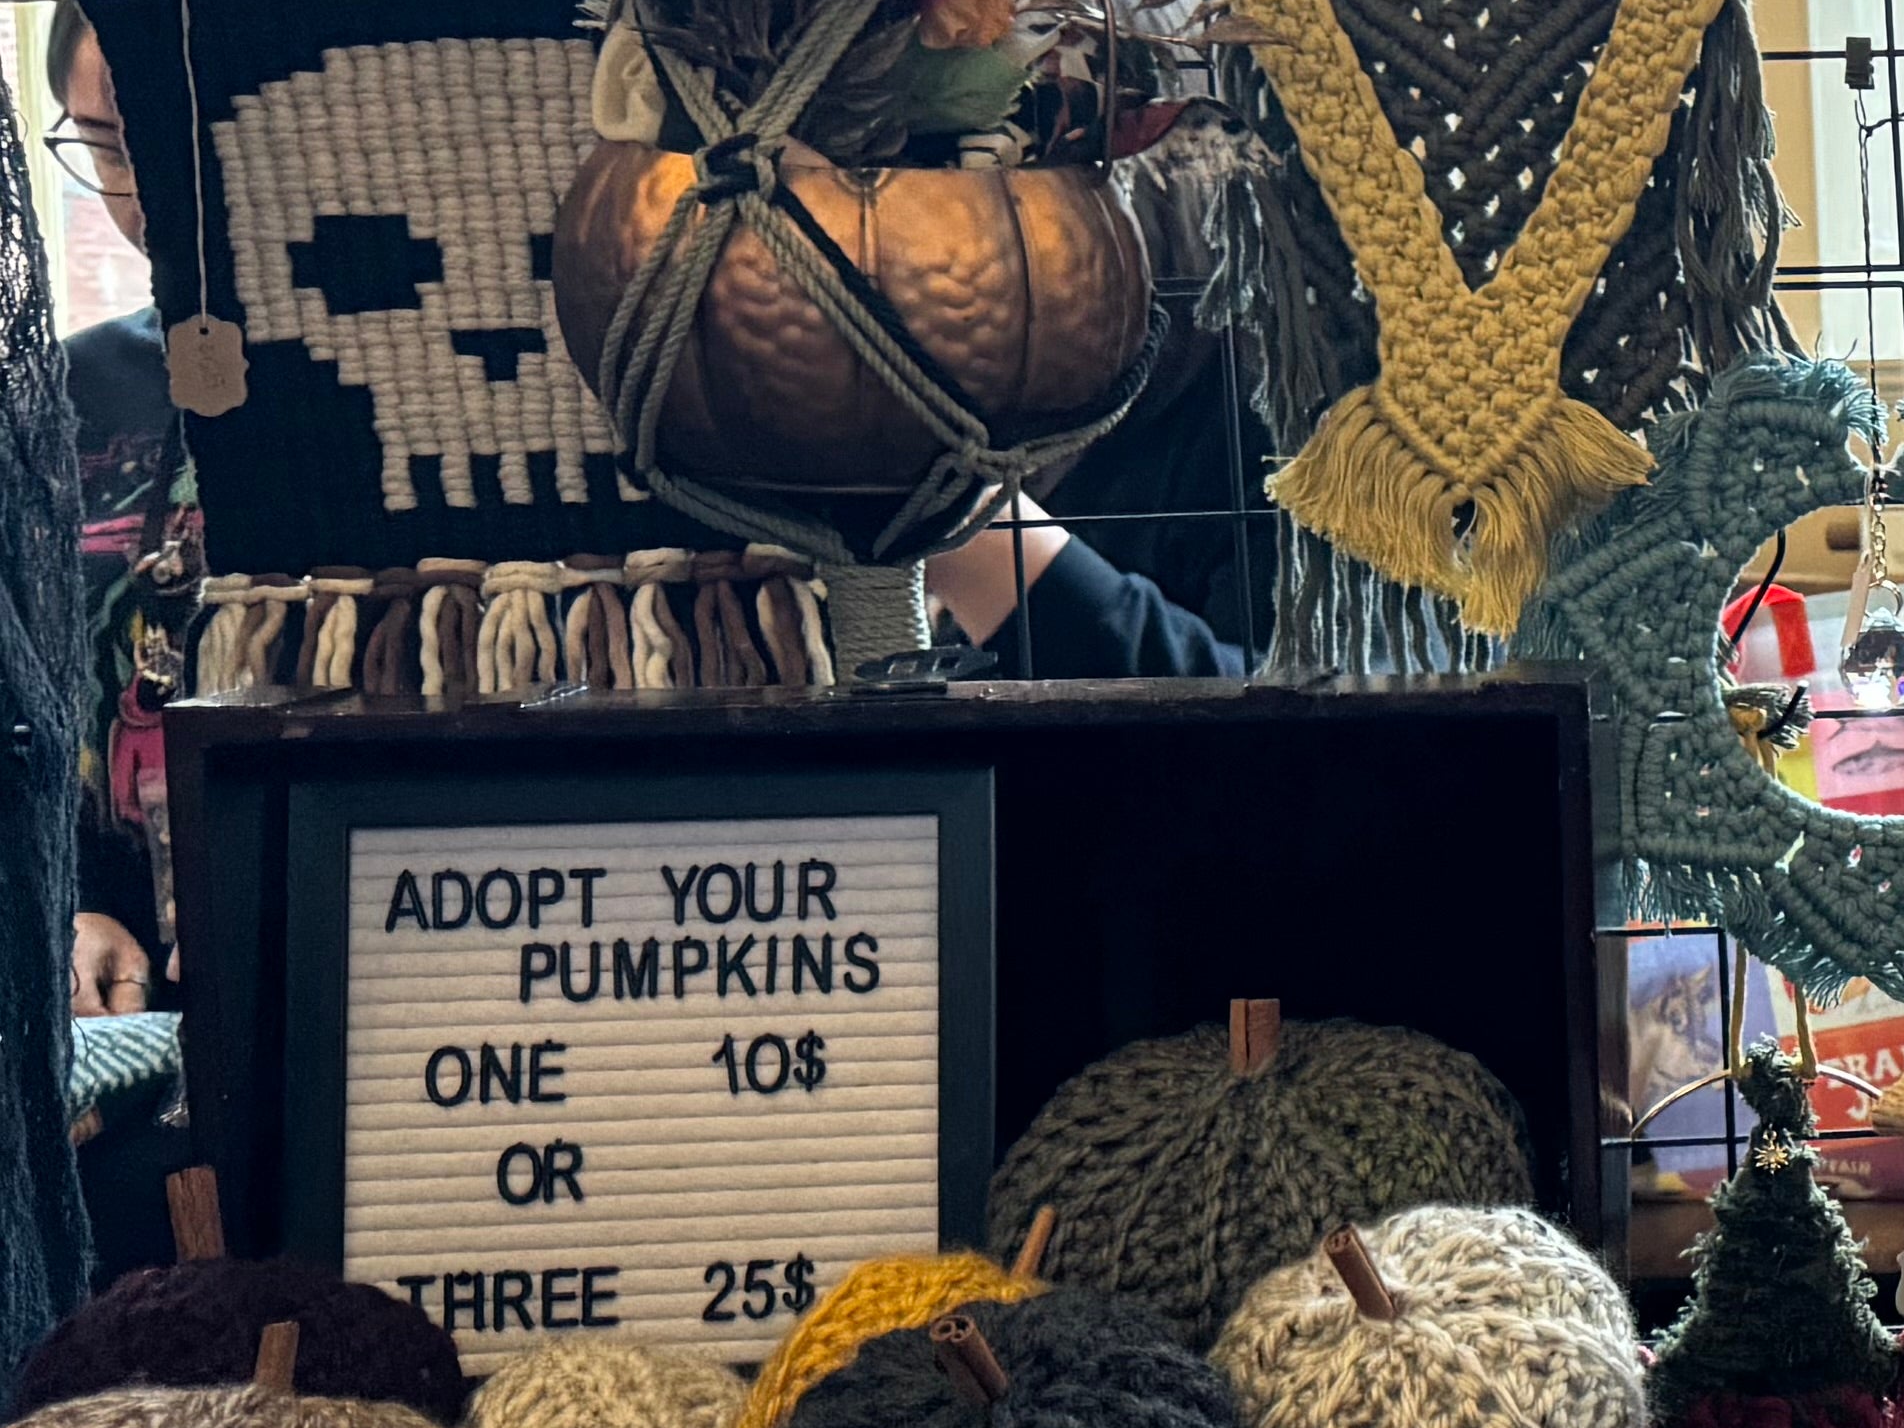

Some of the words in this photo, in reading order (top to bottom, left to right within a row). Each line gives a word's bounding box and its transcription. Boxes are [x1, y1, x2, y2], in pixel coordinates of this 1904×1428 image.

[385, 867, 607, 933] ADOPT
[660, 857, 838, 926] YOUR
[518, 930, 881, 1004] PUMPKINS
[424, 1038, 568, 1108] ONE
[711, 1029, 828, 1096] 10$
[496, 1138, 584, 1205] OR
[395, 1264, 622, 1333] THREE
[701, 1251, 816, 1323] 25$
